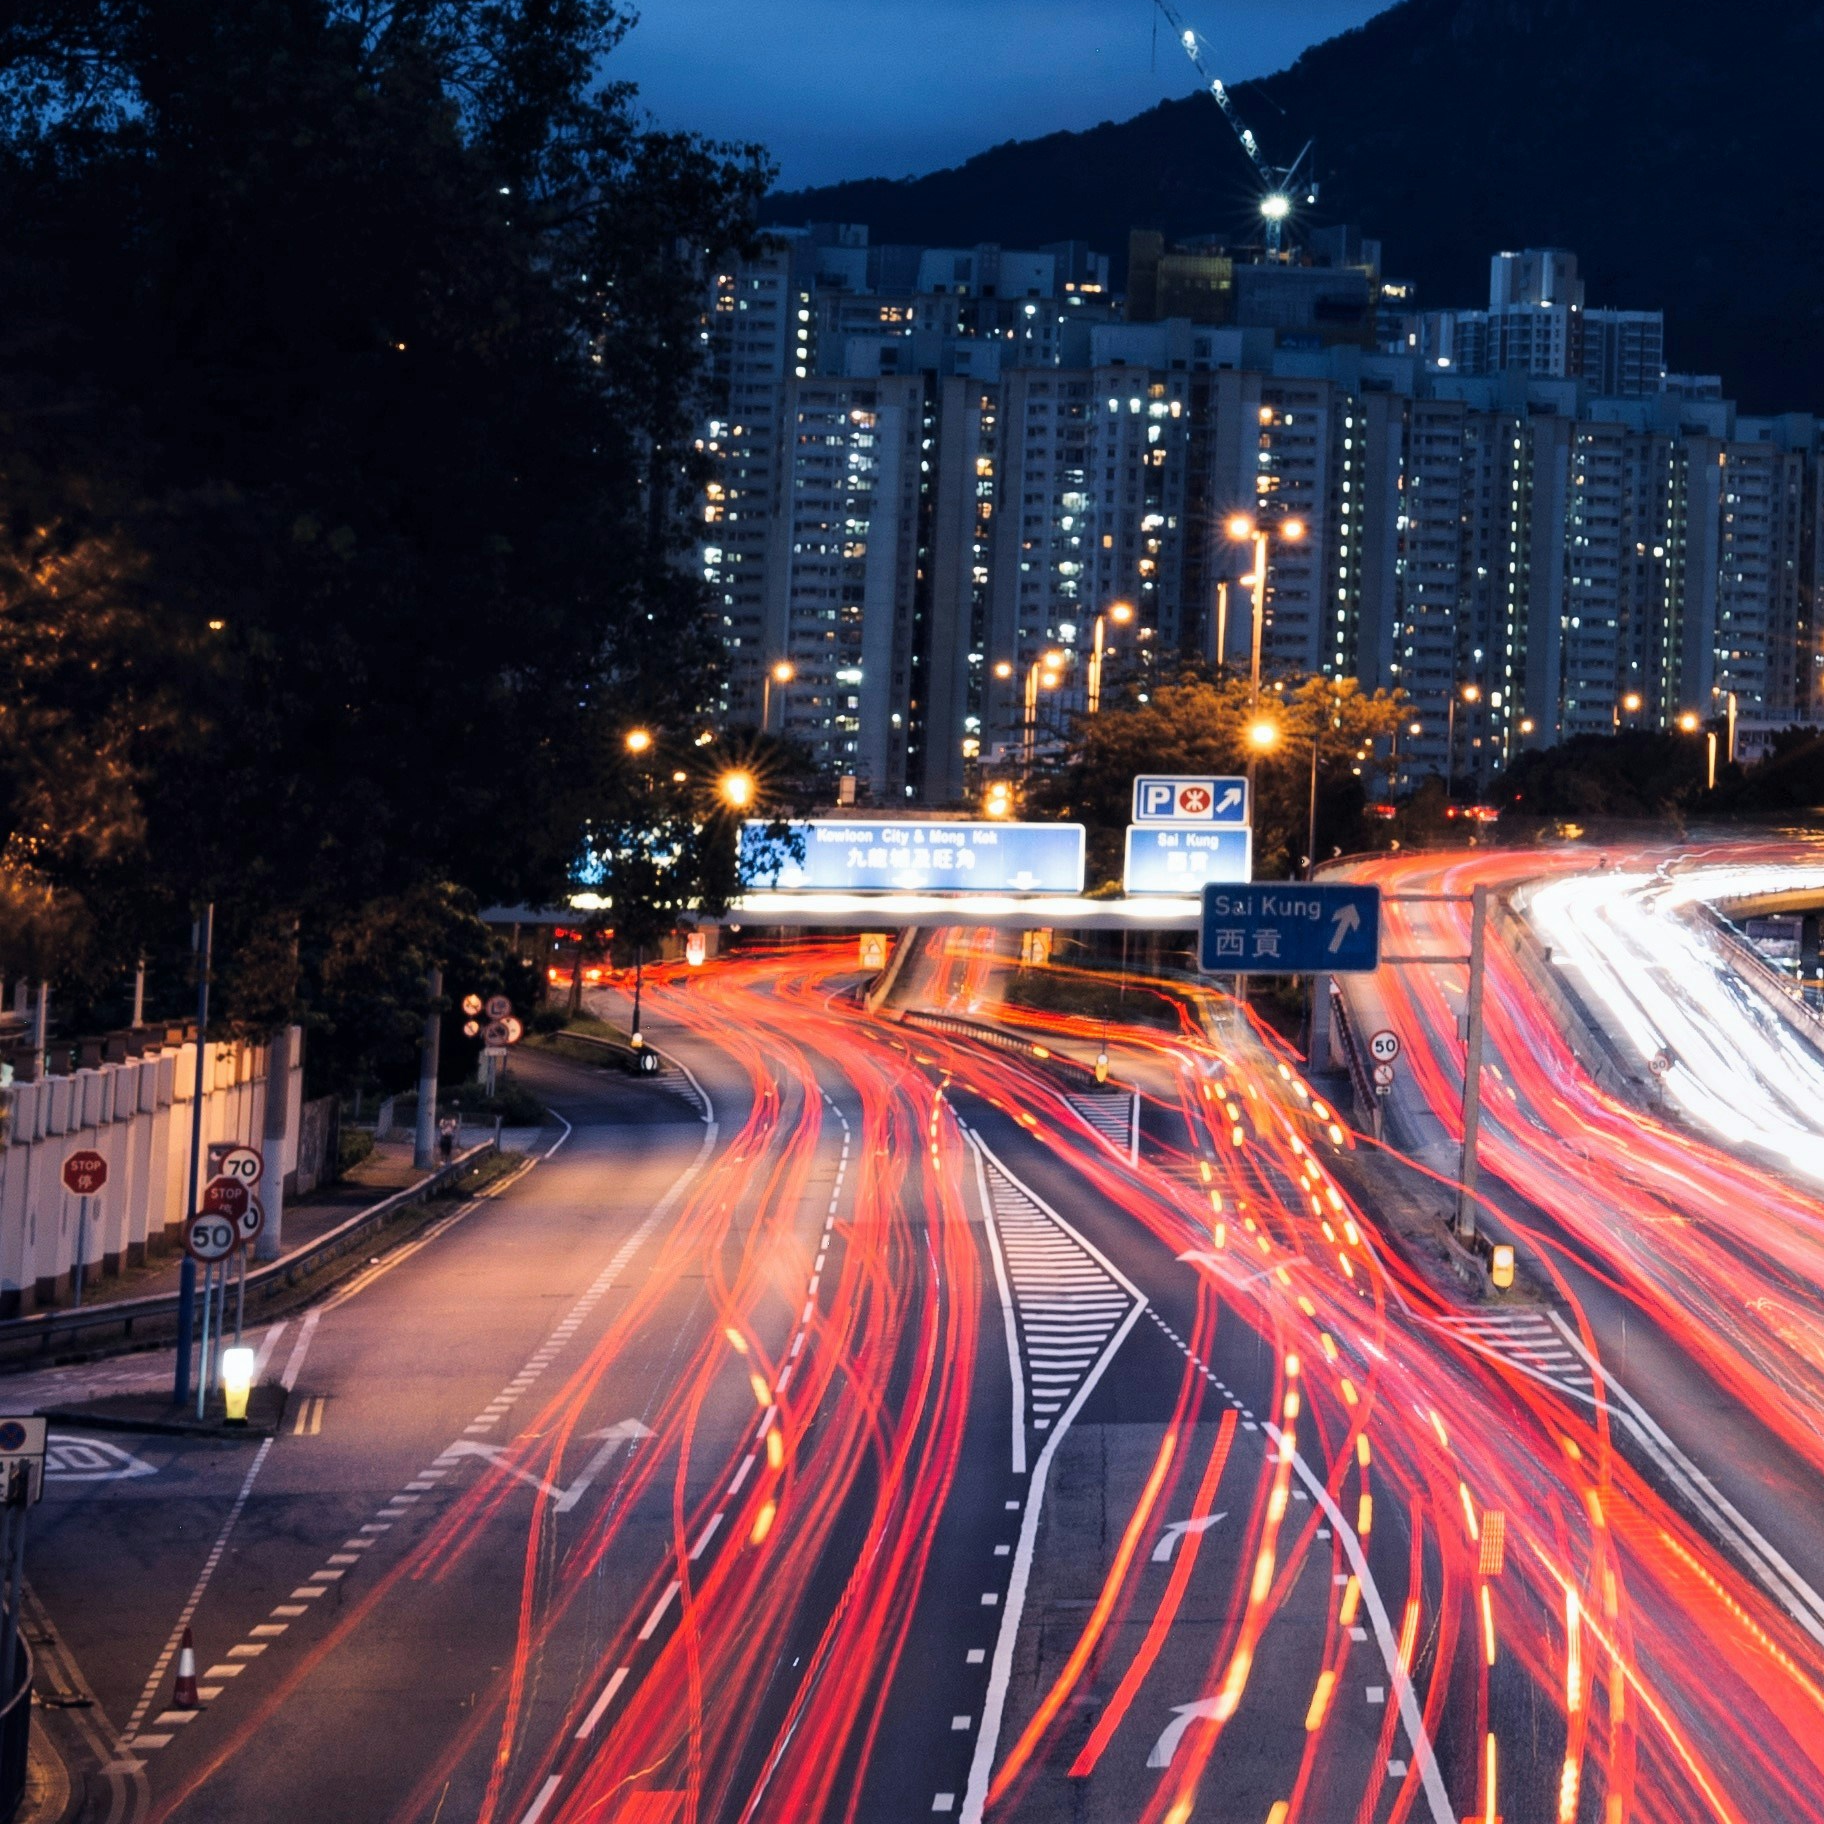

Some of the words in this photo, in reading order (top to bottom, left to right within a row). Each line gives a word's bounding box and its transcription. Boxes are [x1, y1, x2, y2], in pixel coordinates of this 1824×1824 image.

[1147, 786, 1170, 814] P
[817, 829, 873, 843] Kowloon
[881, 829, 909, 845] City
[913, 829, 924, 843] &
[930, 829, 965, 846] Mong
[972, 830, 997, 844] Kok
[1157, 832, 1179, 847] Sai
[1186, 833, 1219, 850] Kung
[1215, 895, 1253, 916] Sai
[1261, 895, 1322, 919] Kung
[1215, 928, 1282, 958] 西貢
[1375, 1039, 1395, 1053] 50
[71, 1160, 101, 1172] STOP
[228, 1160, 256, 1177] 70
[210, 1188, 242, 1199] STOP
[193, 1225, 231, 1248] 50
